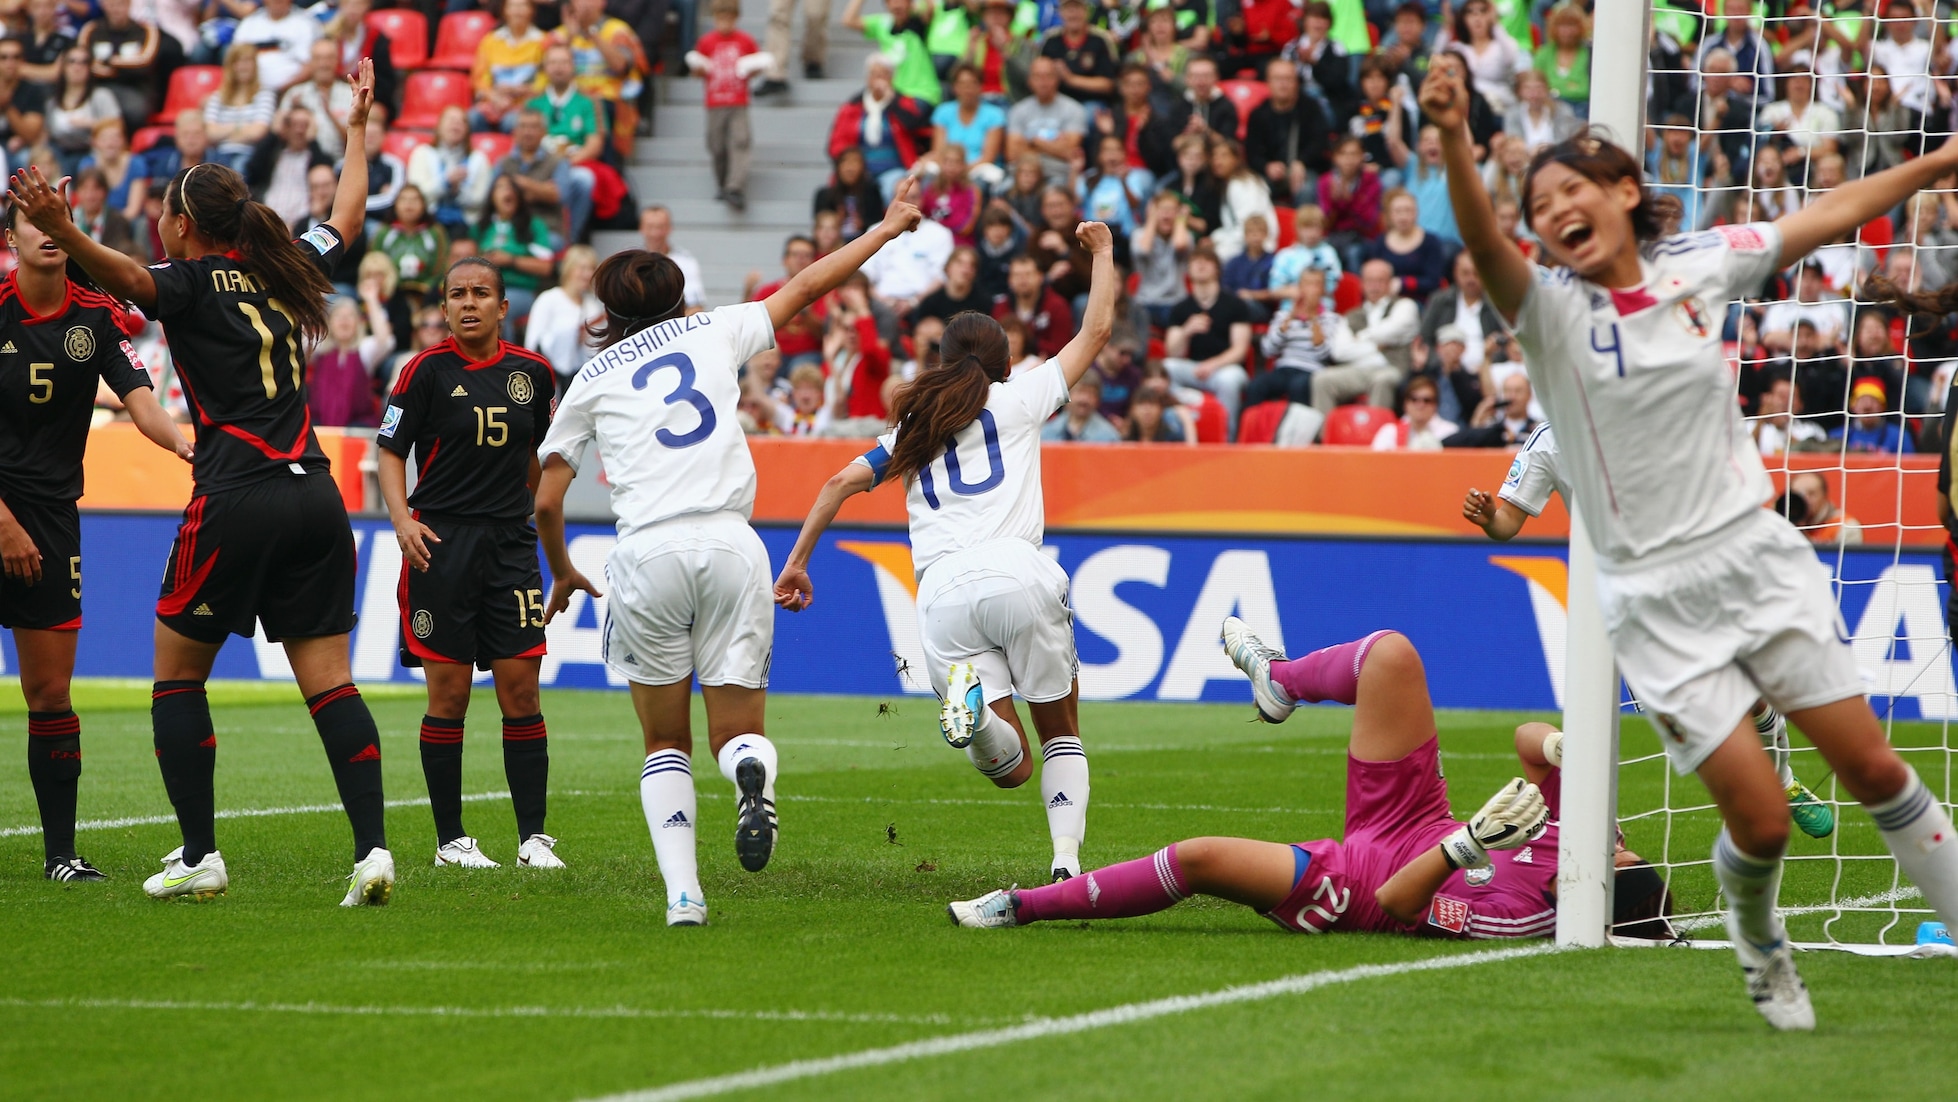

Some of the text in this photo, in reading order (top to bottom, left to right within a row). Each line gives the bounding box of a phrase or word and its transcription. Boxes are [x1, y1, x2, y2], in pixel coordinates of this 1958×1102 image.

[237, 297, 301, 400] 11
[581, 313, 711, 383] IWASHIMIZU
[1590, 322, 1625, 377] 4
[29, 363, 55, 404] 5
[631, 352, 717, 449] 3
[473, 405, 509, 447] 15
[919, 408, 1005, 511] 10
[513, 589, 546, 629] 15
[1048, 800, 1074, 809] adidas
[1296, 875, 1351, 935] 20
